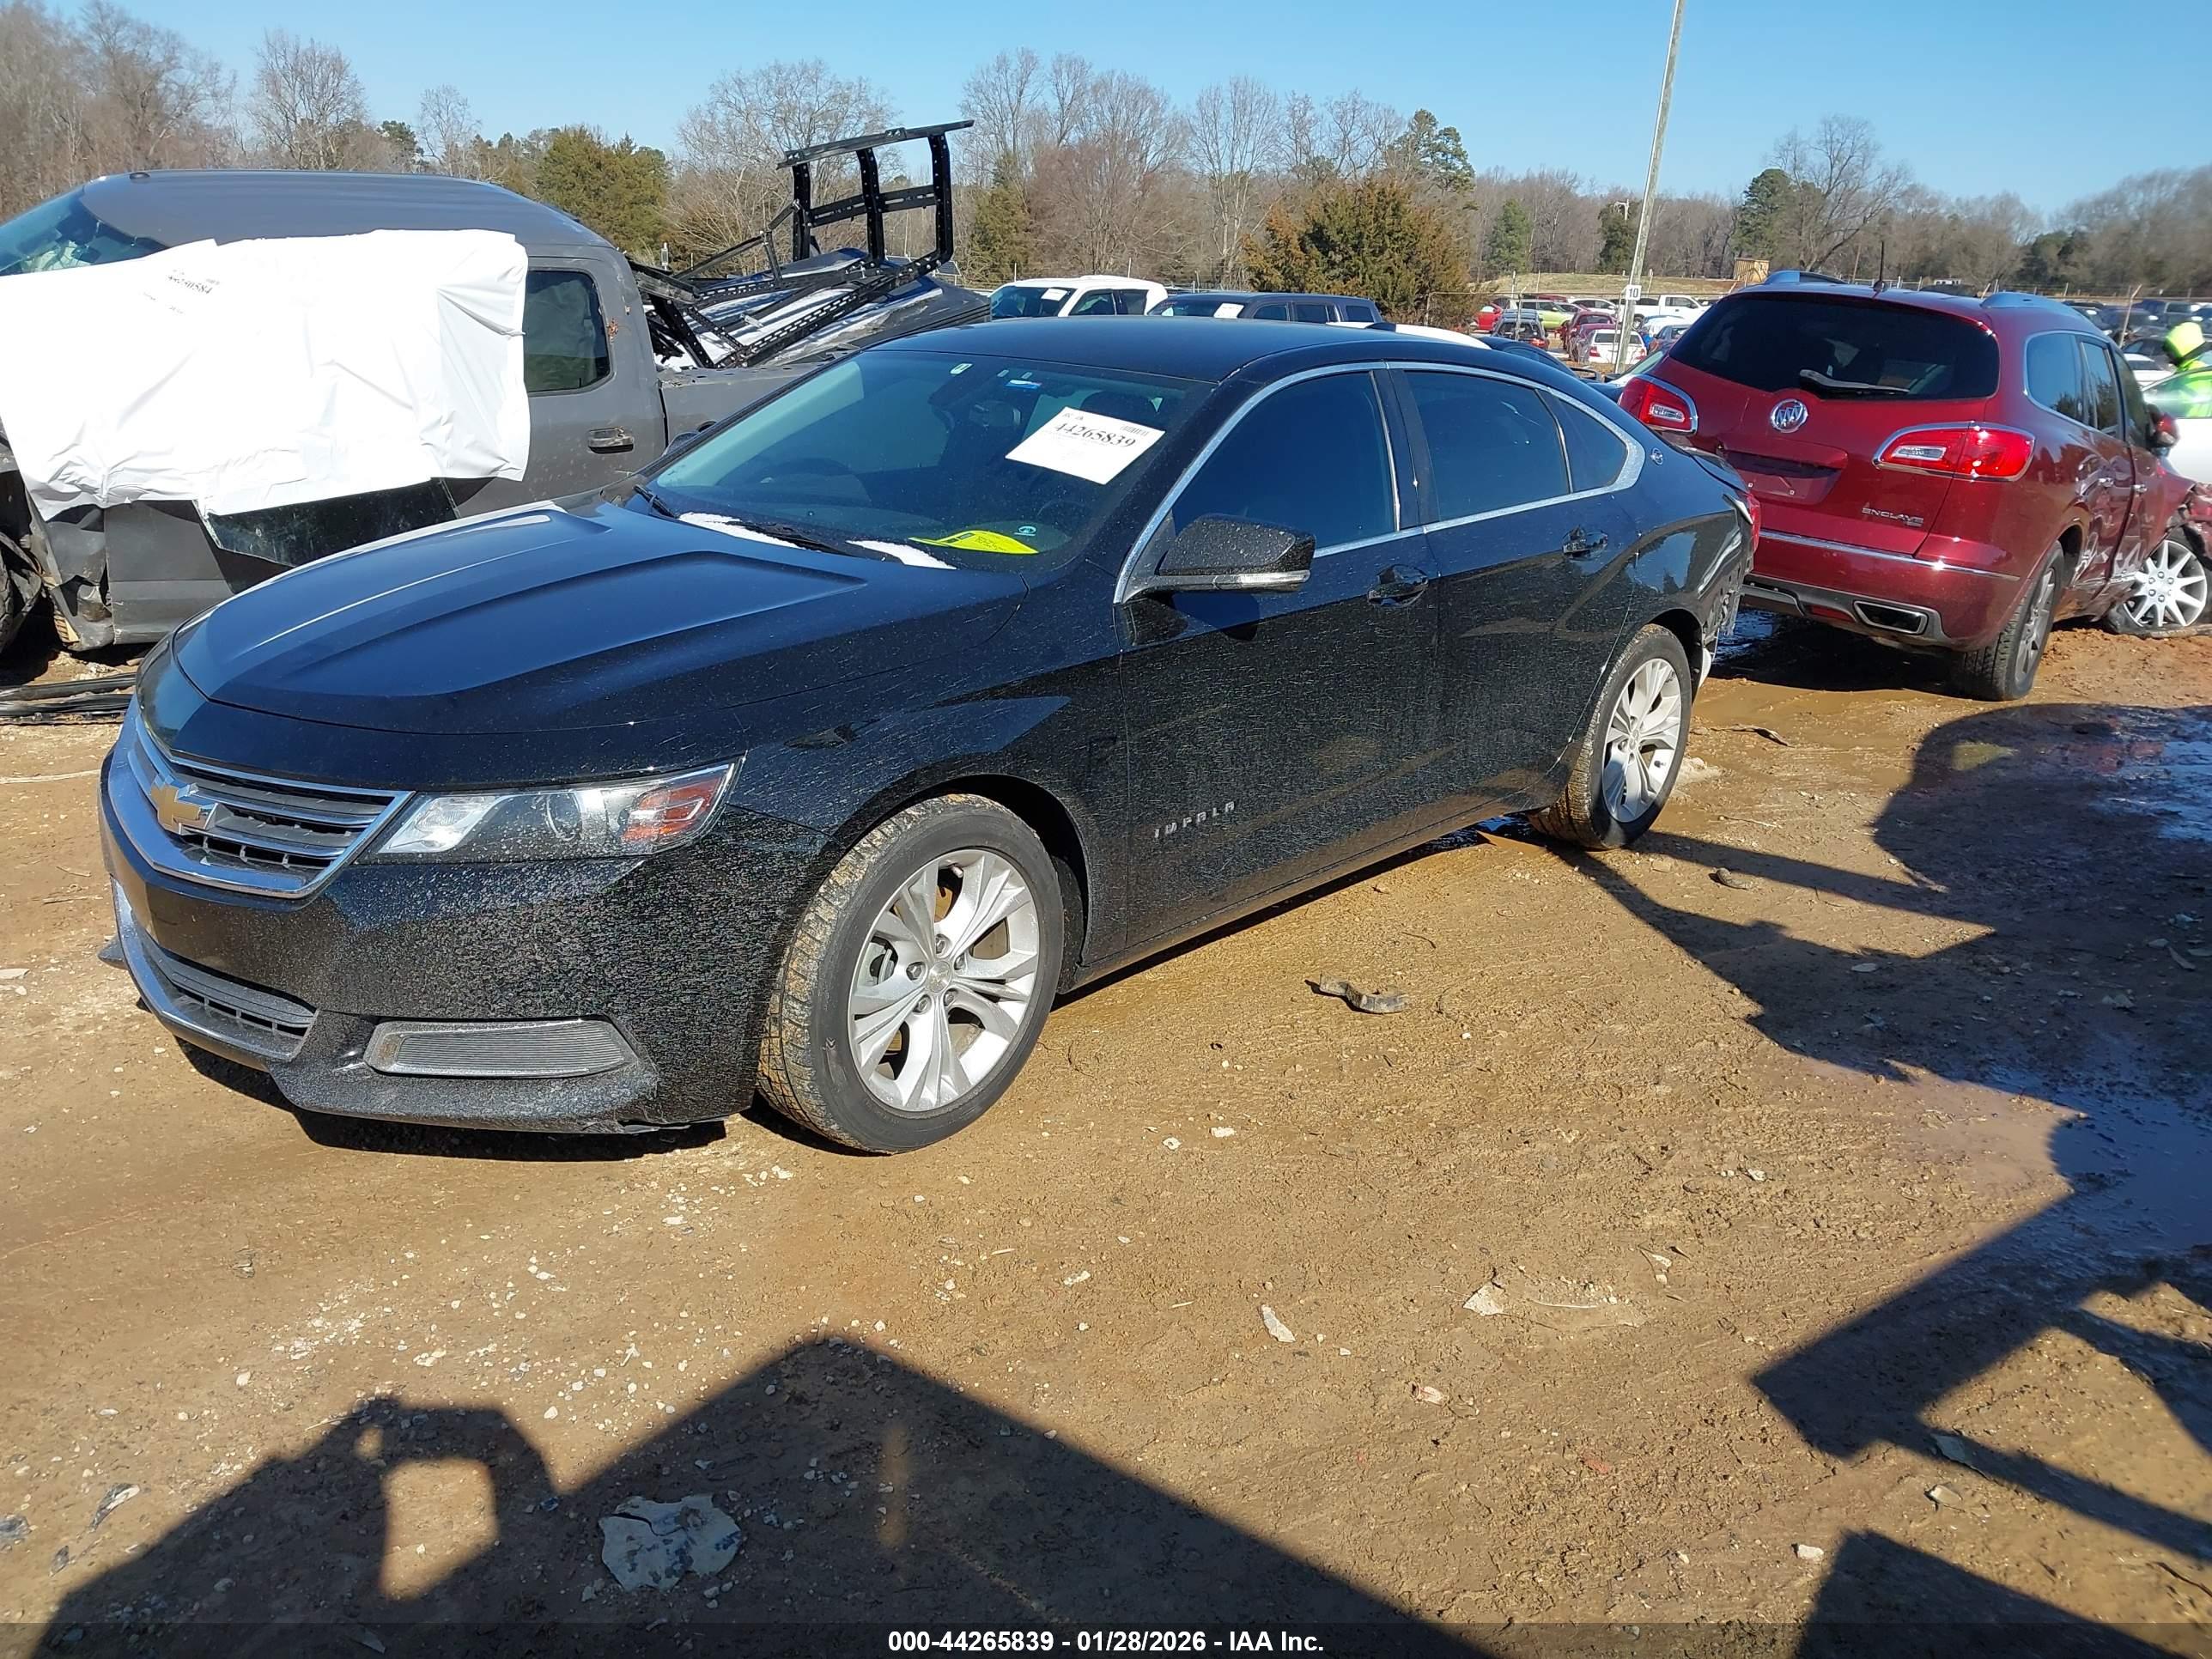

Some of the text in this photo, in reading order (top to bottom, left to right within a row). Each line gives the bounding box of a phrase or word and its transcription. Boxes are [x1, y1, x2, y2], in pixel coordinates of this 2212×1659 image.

[1628, 288, 1639, 298] 10
[1054, 422, 1137, 447] 44265839
[1861, 507, 1924, 524] ENCLAVE
[1153, 800, 1235, 839] IMPALA
